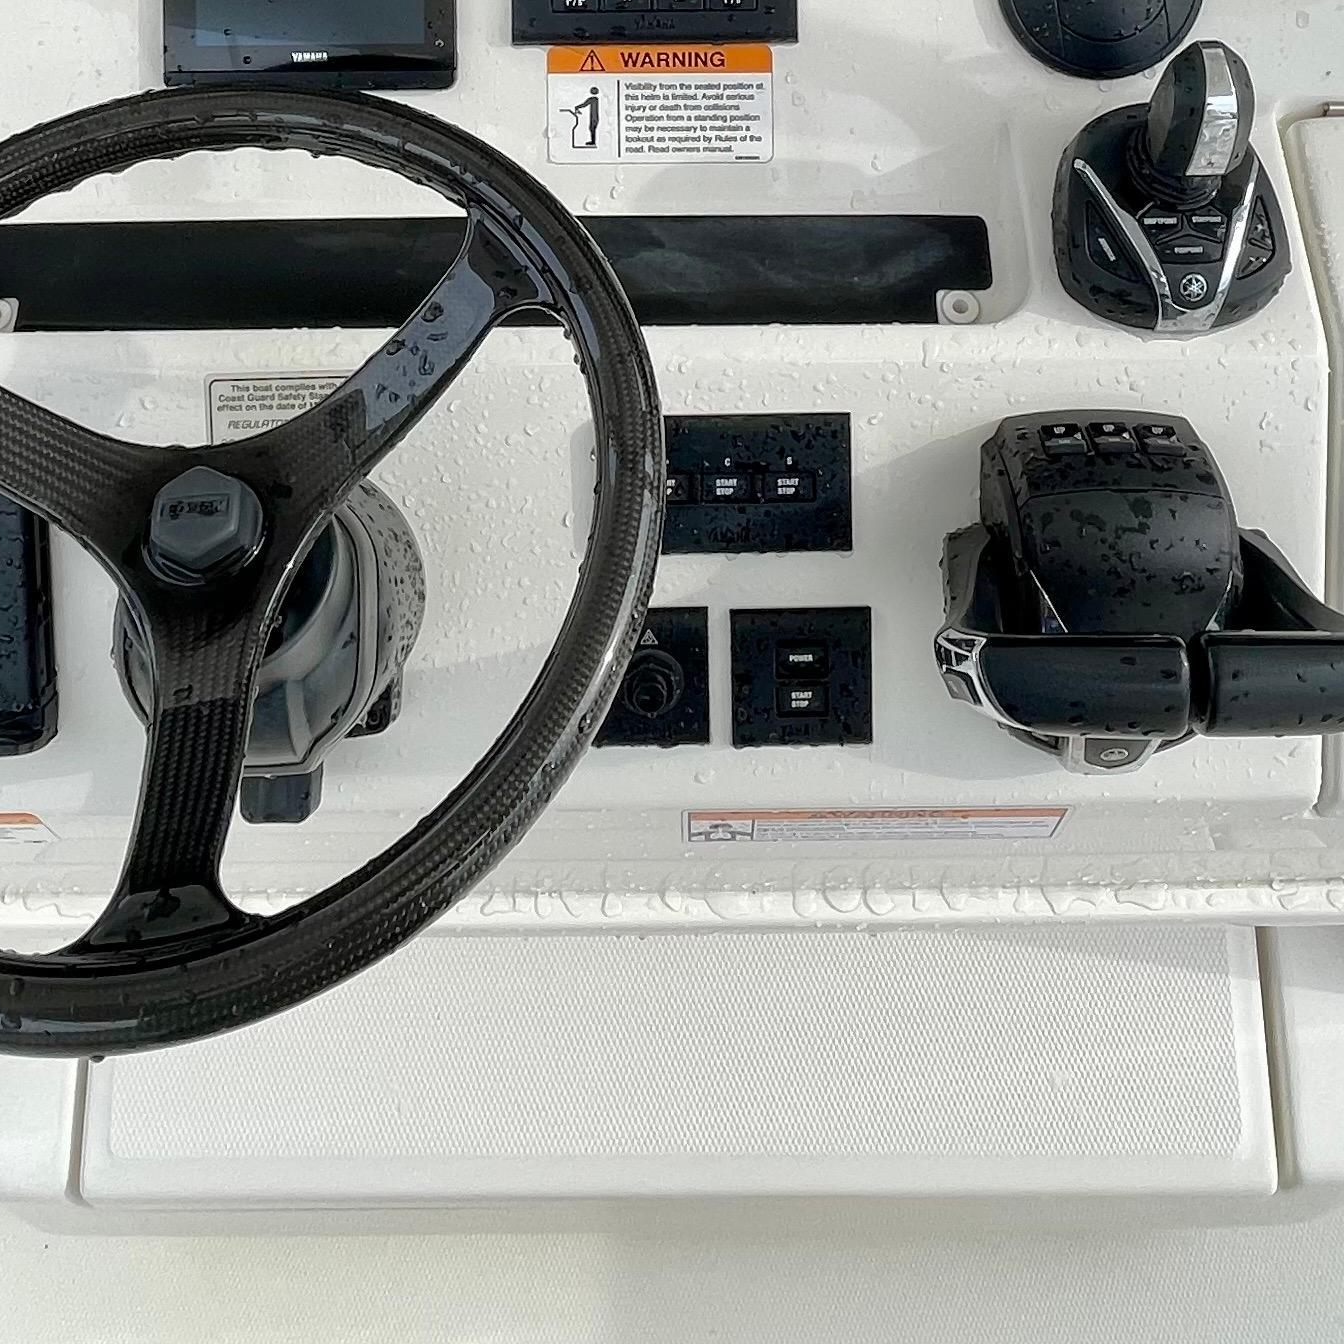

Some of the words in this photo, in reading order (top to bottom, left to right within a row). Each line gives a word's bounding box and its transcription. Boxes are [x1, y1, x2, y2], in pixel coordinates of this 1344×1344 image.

[291, 52, 328, 62] YAMAHA
[620, 52, 725, 68] WARNING
[624, 83, 657, 92] Visibility
[723, 83, 753, 92] position
[625, 104, 646, 113] injury
[625, 115, 664, 123] Operation
[694, 115, 727, 123] standing
[730, 115, 760, 123] position
[625, 125, 642, 134] may
[656, 125, 697, 134] necessary
[668, 135, 701, 144] required
[703, 135, 712, 144] by
[253, 384, 272, 392] boat
[275, 383, 315, 392] complies
[247, 393, 275, 402] Guard
[277, 393, 305, 402] Safety
[217, 404, 242, 412] effect
[298, 402, 306, 410] of
[777, 478, 799, 486] START
